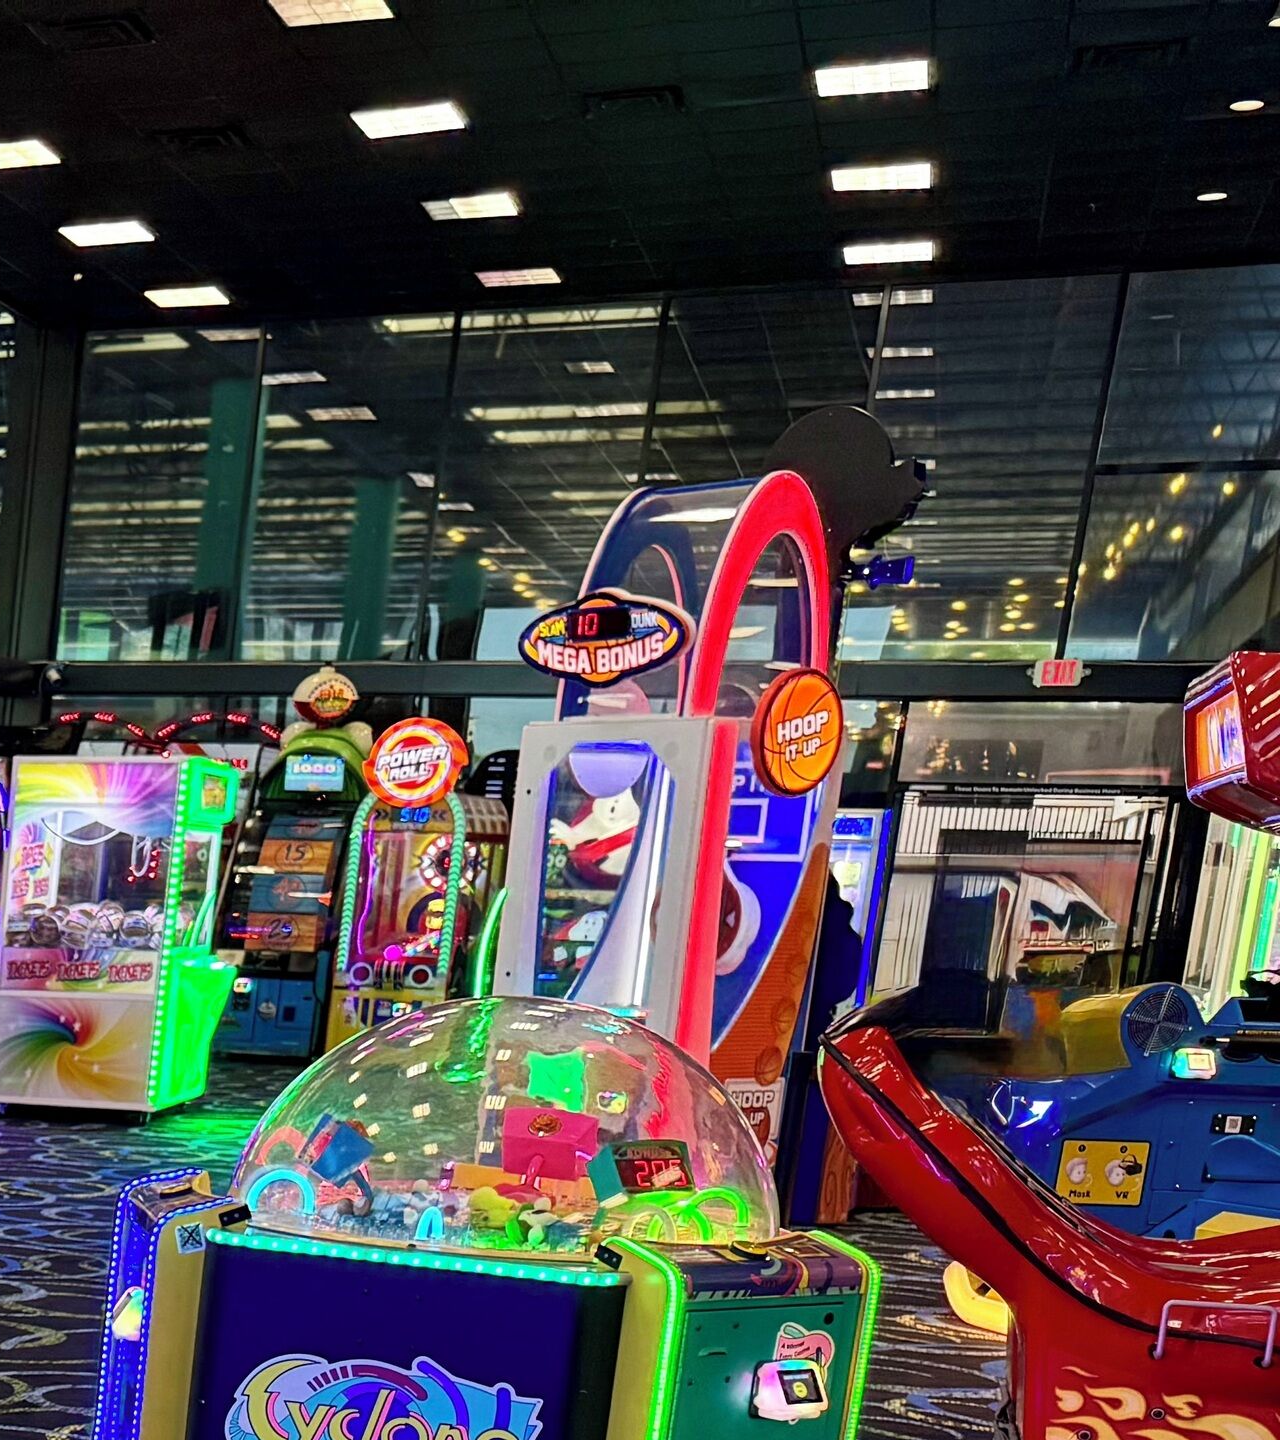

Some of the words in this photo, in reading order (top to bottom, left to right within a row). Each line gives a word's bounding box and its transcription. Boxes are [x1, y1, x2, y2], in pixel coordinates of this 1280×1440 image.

[539, 619, 566, 638] SLAM
[631, 612, 658, 628] DUNK
[538, 642, 591, 674] MEGA
[596, 632, 664, 673] BONUS
[1041, 661, 1077, 684] EXIT
[777, 711, 829, 744] HOOP
[376, 746, 449, 771] POWER
[785, 743, 798, 763] IT
[803, 736, 821, 757] UP
[388, 763, 431, 781] ROLL
[7, 960, 51, 980] TICKETS
[56, 961, 100, 982] TICKETS
[107, 963, 153, 983] TICKETS
[732, 1090, 775, 1108] HOOP
[750, 1112, 765, 1126] UP
[1068, 1190, 1090, 1198] Mask
[1115, 1191, 1129, 1199] VR
